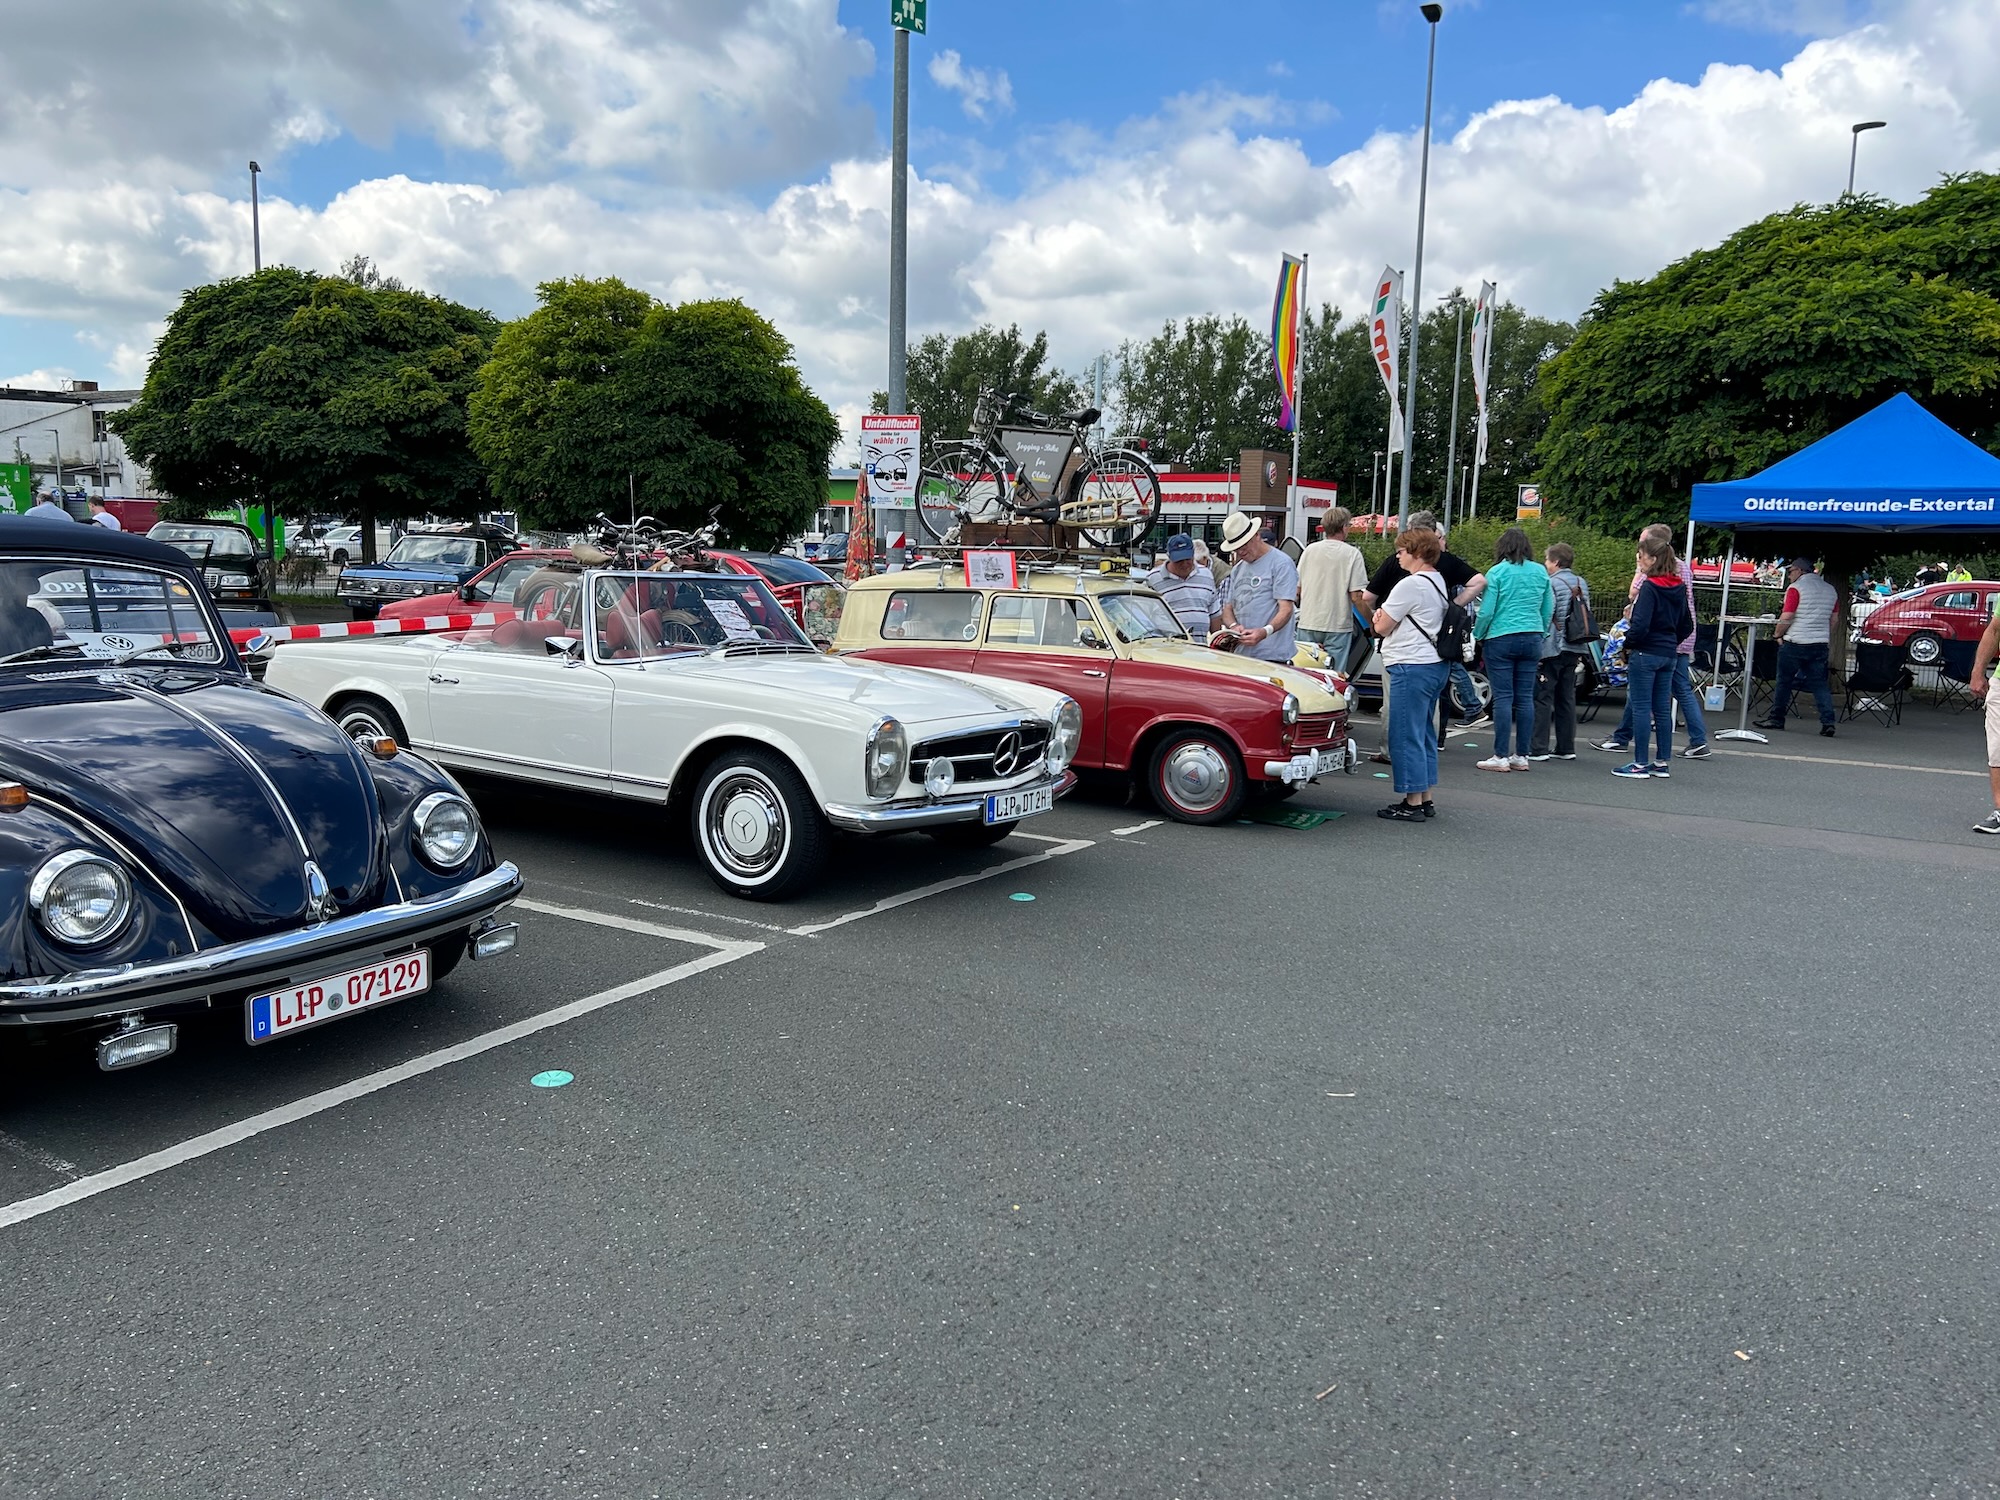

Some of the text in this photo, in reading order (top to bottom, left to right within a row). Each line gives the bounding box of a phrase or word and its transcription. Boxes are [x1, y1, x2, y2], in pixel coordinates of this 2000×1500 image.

[864, 417, 917, 429] Unfallflucht
[873, 437, 909, 445] wähle 110
[1035, 457, 1046, 467] for
[1160, 493, 1235, 504] BURGER KING
[1743, 497, 1995, 512] Oldtimerfreunde-Extertal
[996, 796, 1016, 817] LIP
[1023, 792, 1034, 812] DT
[1035, 789, 1047, 809] 2H
[275, 959, 421, 1027] LIP 07129
[258, 1021, 266, 1031] D
